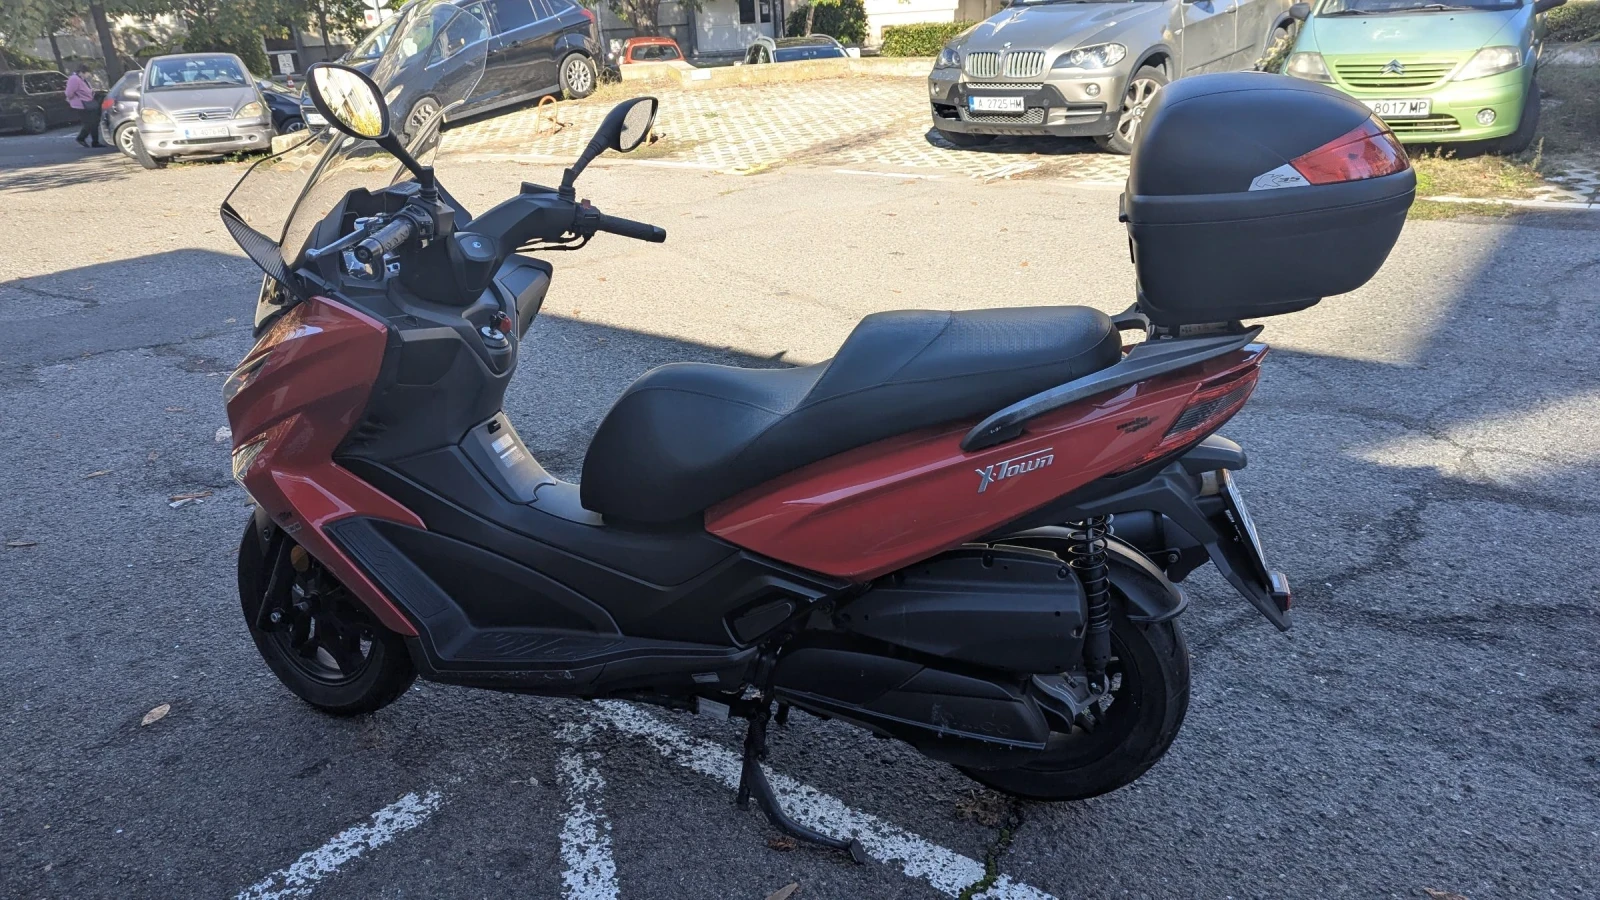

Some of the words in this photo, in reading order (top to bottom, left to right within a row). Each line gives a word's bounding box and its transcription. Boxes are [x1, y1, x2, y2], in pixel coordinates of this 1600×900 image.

[988, 99, 1008, 109] 2725
[1010, 98, 1021, 109] HM
[1374, 102, 1406, 114] 8017
[1409, 101, 1427, 113] MP
